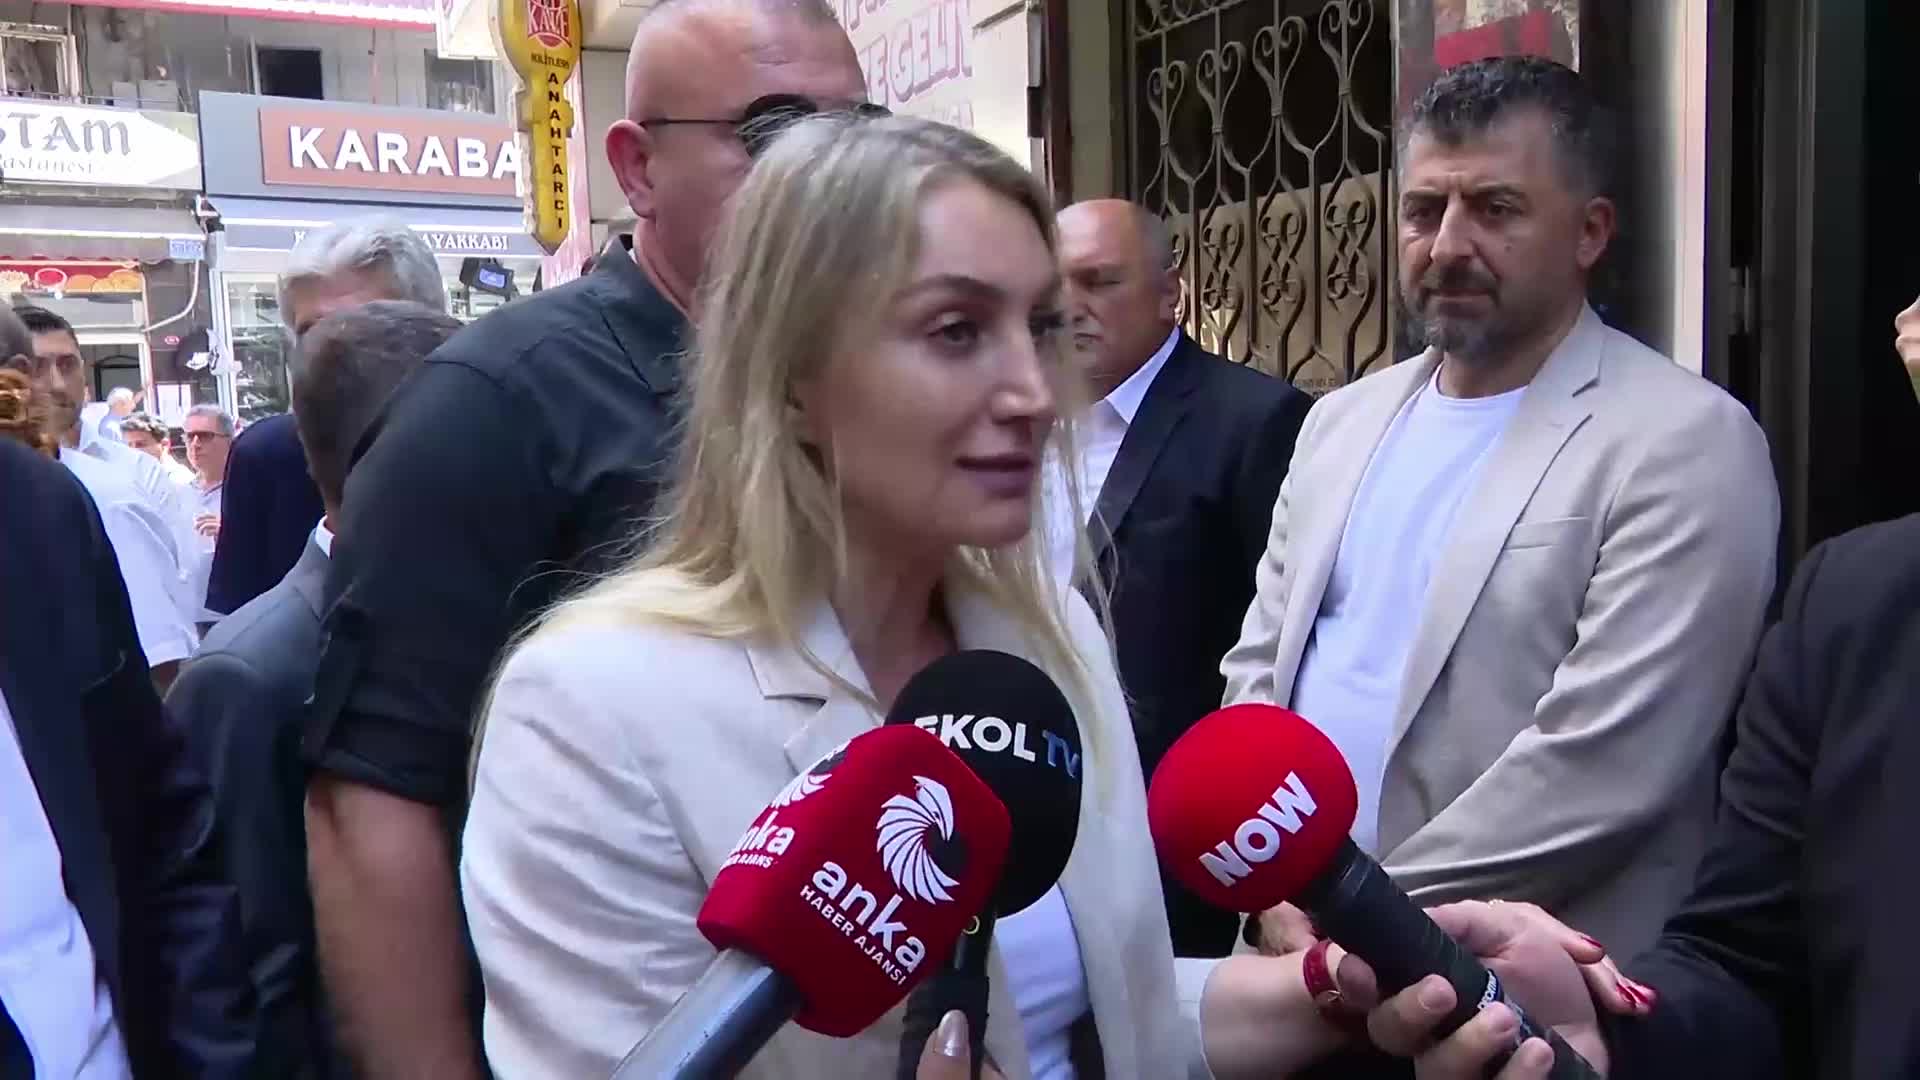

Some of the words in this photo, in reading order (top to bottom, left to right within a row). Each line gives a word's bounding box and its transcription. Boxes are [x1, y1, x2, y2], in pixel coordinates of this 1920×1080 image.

[0, 112, 131, 156] TAM
[289, 125, 520, 180] KARABA
[548, 72, 565, 229] ANAHTARCI
[0, 157, 93, 174] astanesi
[1042, 729, 1080, 778] TV
[730, 810, 795, 856] nka
[1198, 770, 1317, 887] NOW
[800, 885, 855, 936] HABER
[812, 861, 926, 973] anka
